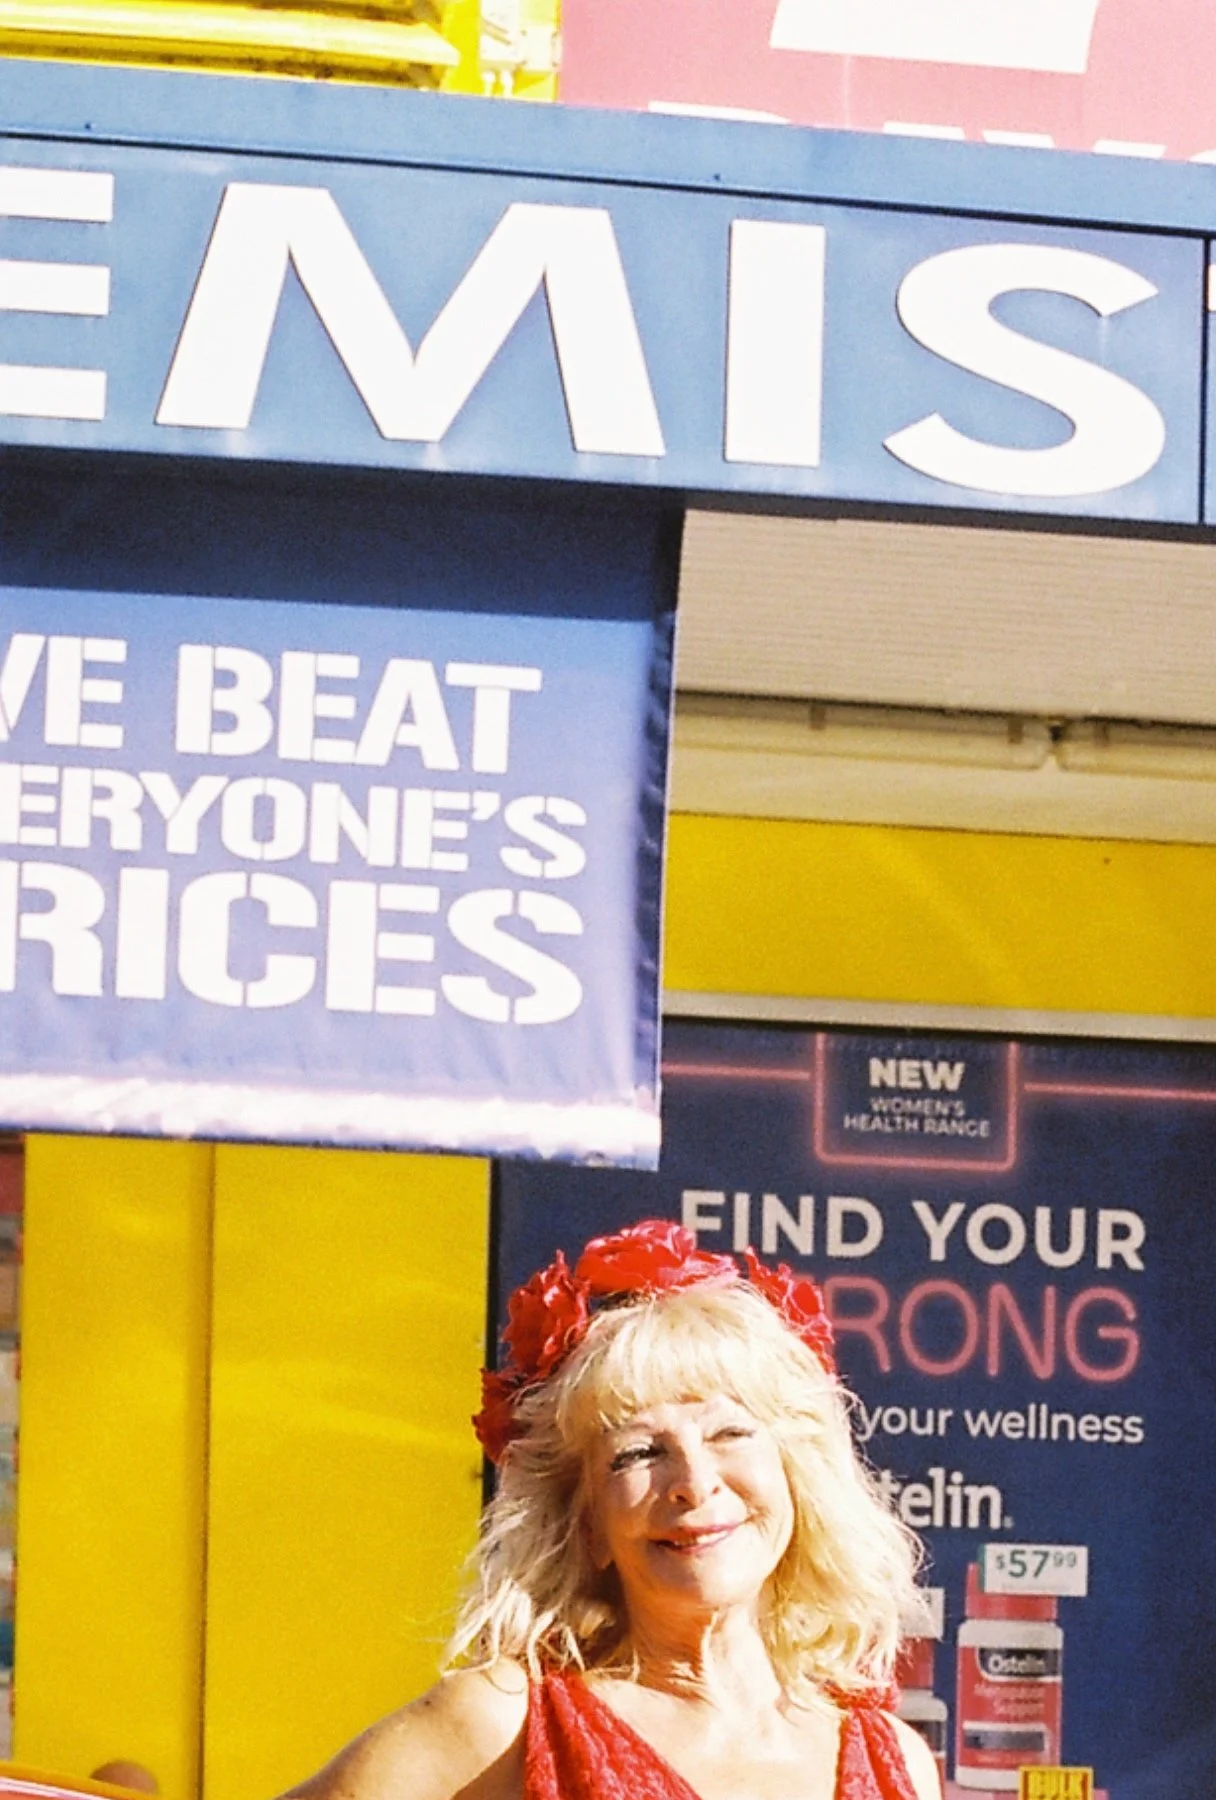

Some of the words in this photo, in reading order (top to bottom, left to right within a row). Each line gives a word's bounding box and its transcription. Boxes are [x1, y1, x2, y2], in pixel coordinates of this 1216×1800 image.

[175, 644, 542, 774] BEAT
[0, 859, 584, 1024] RICES
[869, 1057, 965, 1091] NEW
[844, 1113, 920, 1133] HEALTH
[924, 1118, 990, 1137] RANGE
[870, 1096, 966, 1117] WOMEN'S
[680, 1189, 884, 1258] FIND
[913, 1201, 1146, 1271] YOUR
[819, 1275, 1140, 1383] RONG
[856, 1405, 953, 1442] your
[964, 1403, 1145, 1443] wellness
